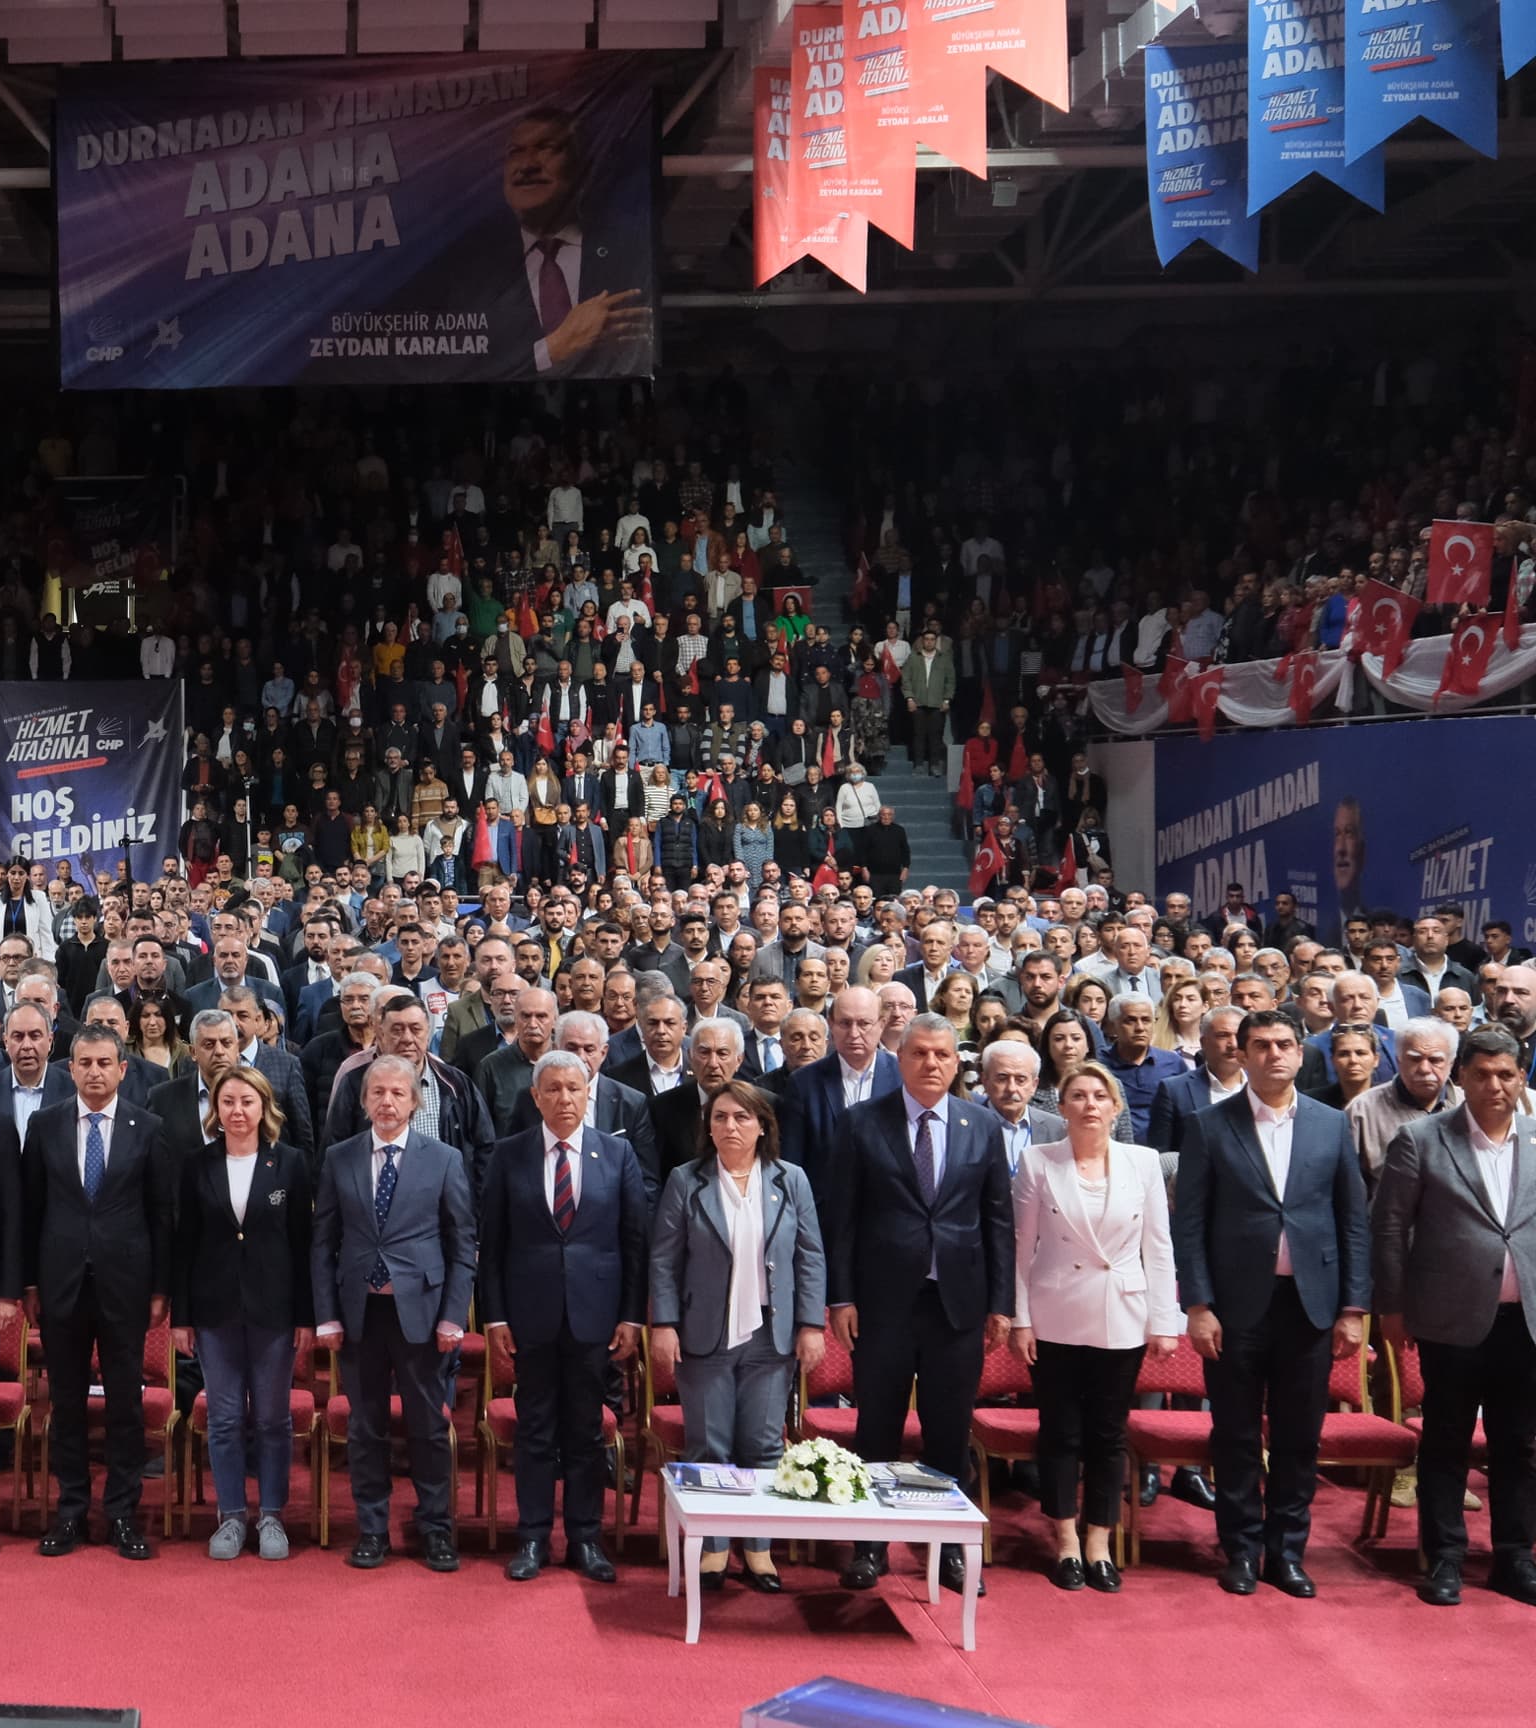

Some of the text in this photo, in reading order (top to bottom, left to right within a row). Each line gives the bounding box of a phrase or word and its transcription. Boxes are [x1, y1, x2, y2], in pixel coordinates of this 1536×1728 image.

[946, 40, 1026, 54] ZEYDAN KARALAR
[1151, 57, 1248, 88] DURMADAN
[1157, 73, 1248, 104] YILMADAN
[1382, 91, 1460, 103] ZEYDAN KARALAR
[76, 64, 529, 171] DURMADAN YILMADAN
[1156, 91, 1248, 129] ADANA
[1156, 117, 1248, 155] ADANA
[184, 131, 400, 218] ADANA
[184, 195, 400, 281] ADANA
[1172, 218, 1231, 228] ZEYDAN KARALAR
[332, 312, 488, 335] BÜYÜKŞEHİR ADANA
[85, 346, 124, 361] CHP
[310, 335, 489, 358] ZEYDAN KARALAR
[16, 709, 94, 740] HİZMET
[5, 735, 89, 762] ATAĞINA
[96, 739, 124, 750] CHP
[11, 786, 75, 827] HOŞ
[1157, 761, 1319, 867] DURMADAN YILMADAN
[11, 808, 157, 861] GELDİNİZ
[1192, 839, 1269, 921] ADANA
